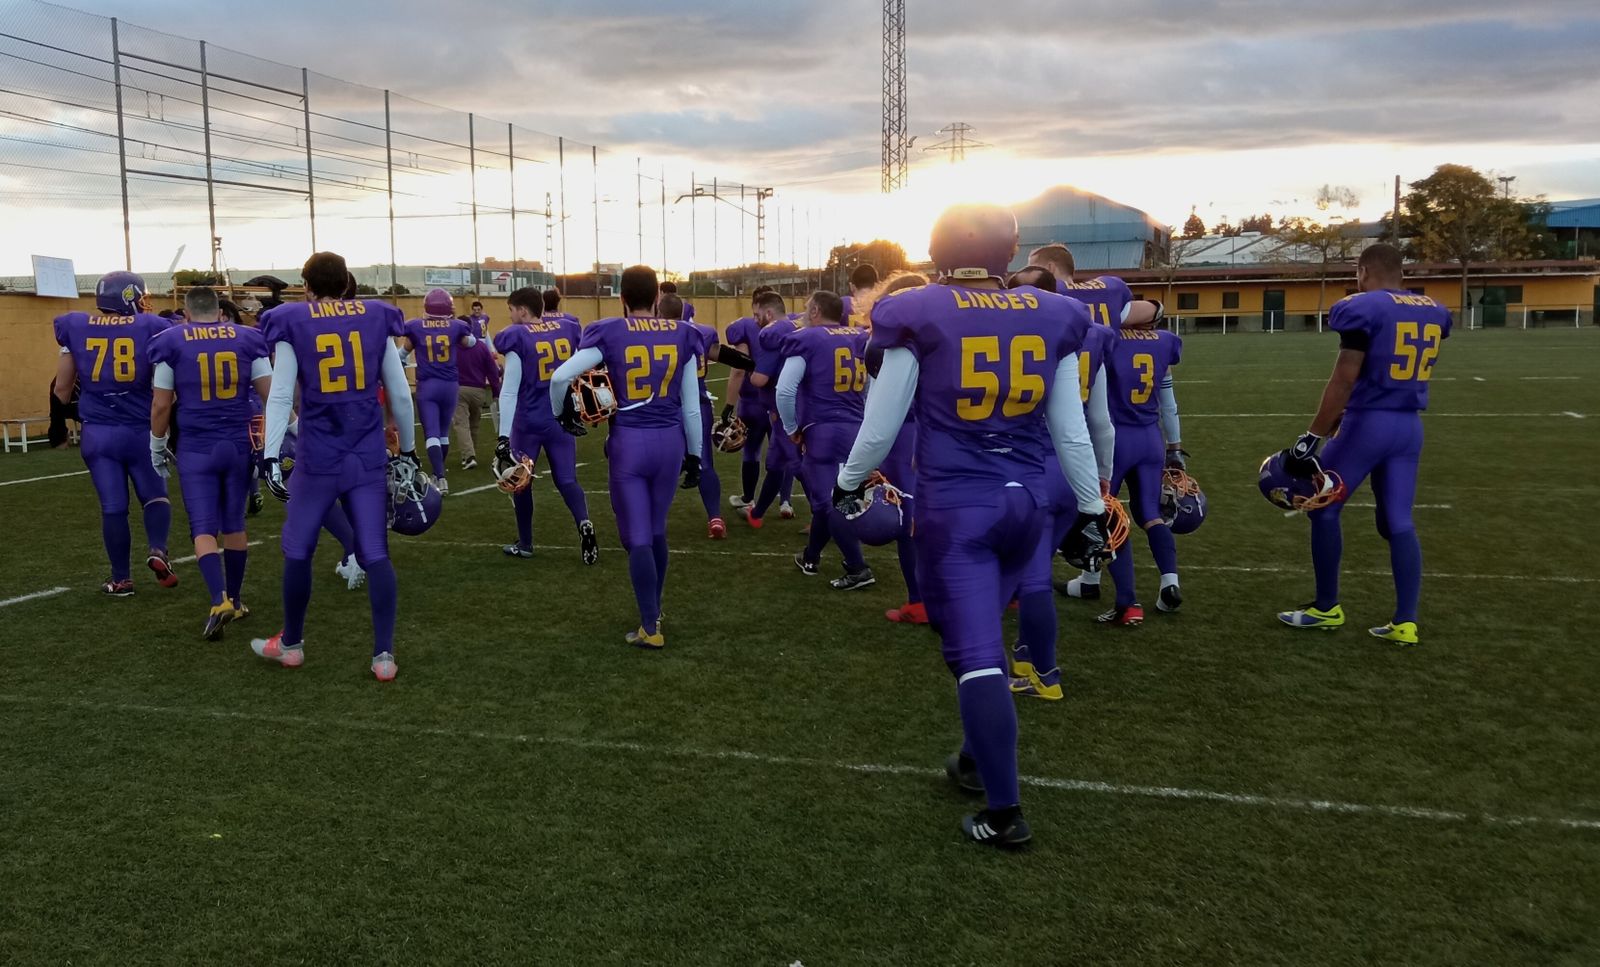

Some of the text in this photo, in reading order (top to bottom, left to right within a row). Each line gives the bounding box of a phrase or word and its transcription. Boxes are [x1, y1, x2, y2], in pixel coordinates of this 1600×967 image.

[308, 300, 366, 318] LINCES
[951, 288, 1039, 310] LINCES
[88, 315, 135, 326] LINCES
[422, 320, 451, 328] LINCES
[523, 321, 561, 333] LINCES
[624, 318, 678, 331] LINCES
[183, 326, 236, 341] LINCES
[1119, 329, 1160, 340] INCES
[86, 337, 136, 382] 78
[425, 335, 450, 362] 13
[1390, 321, 1442, 381] 52
[316, 331, 365, 393] 21
[625, 345, 678, 400] 27
[196, 351, 238, 401] 10
[956, 335, 1046, 421] 56
[1130, 353, 1155, 404] 3
